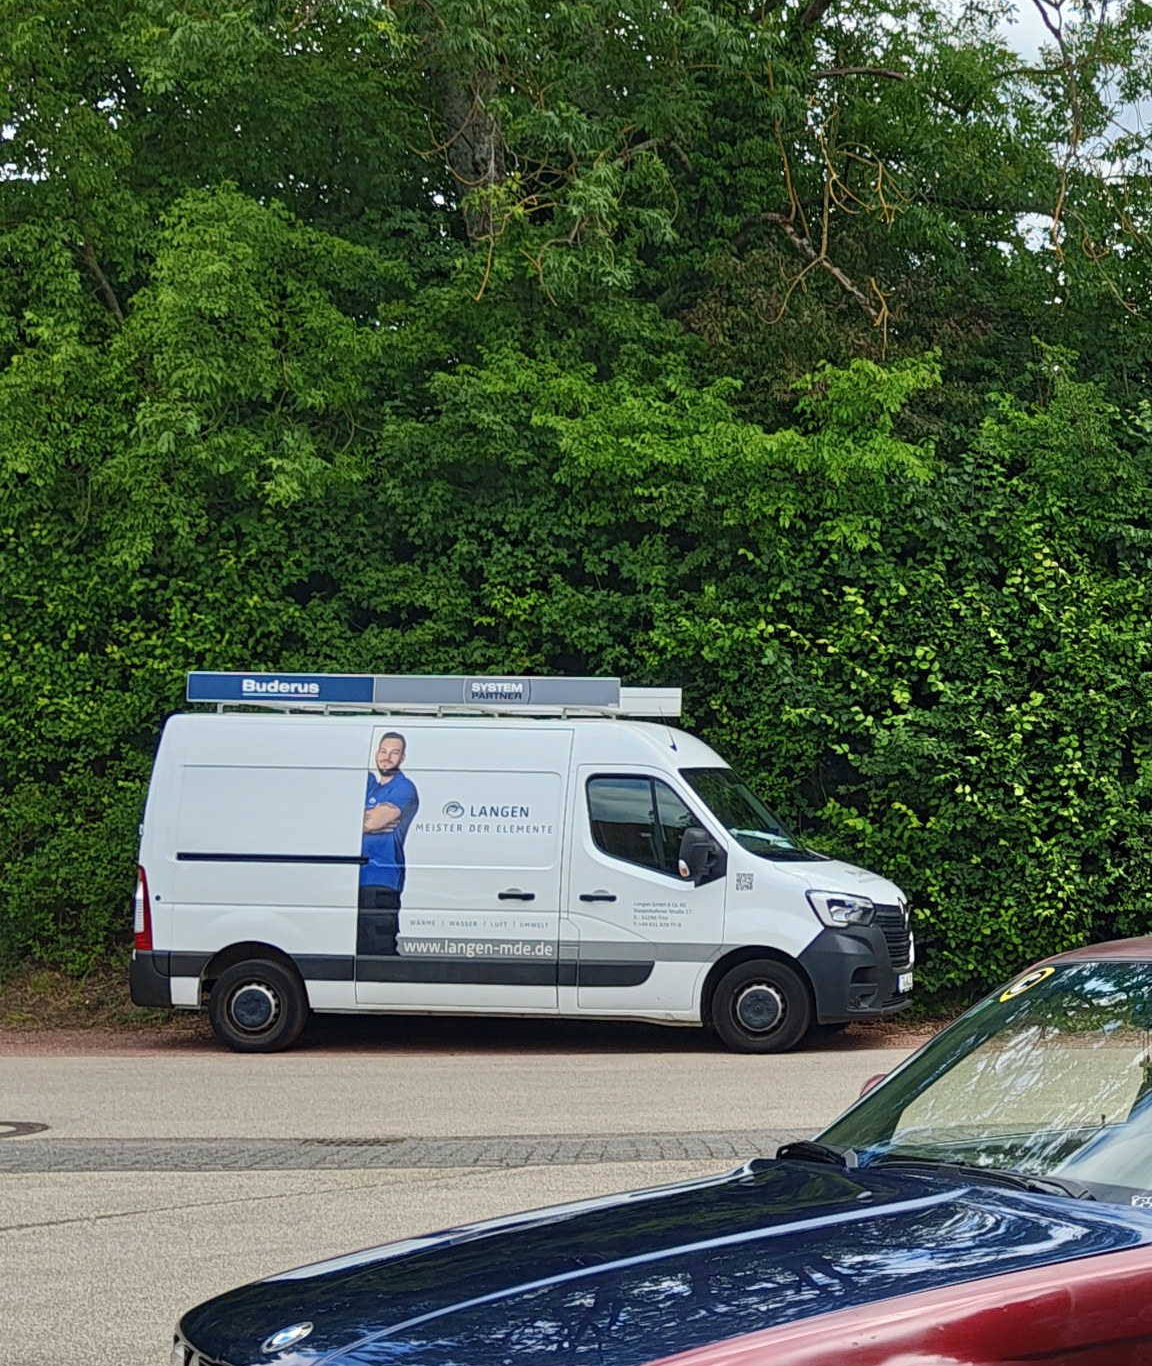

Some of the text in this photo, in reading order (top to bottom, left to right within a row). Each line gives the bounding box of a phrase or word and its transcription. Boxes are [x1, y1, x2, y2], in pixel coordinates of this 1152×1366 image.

[241, 678, 320, 695] Buderus
[471, 682, 523, 693] SYSTEM
[471, 692, 523, 701] PARTNER
[470, 805, 530, 818] LANGEN
[415, 823, 553, 834] MEISTER DER ELEMENTE
[409, 919, 436, 927] WÄRME
[449, 920, 478, 928] WASSER
[490, 921, 508, 929] LUFT
[519, 921, 550, 929] UMWELT
[403, 940, 554, 958] www.langen-mde.de
